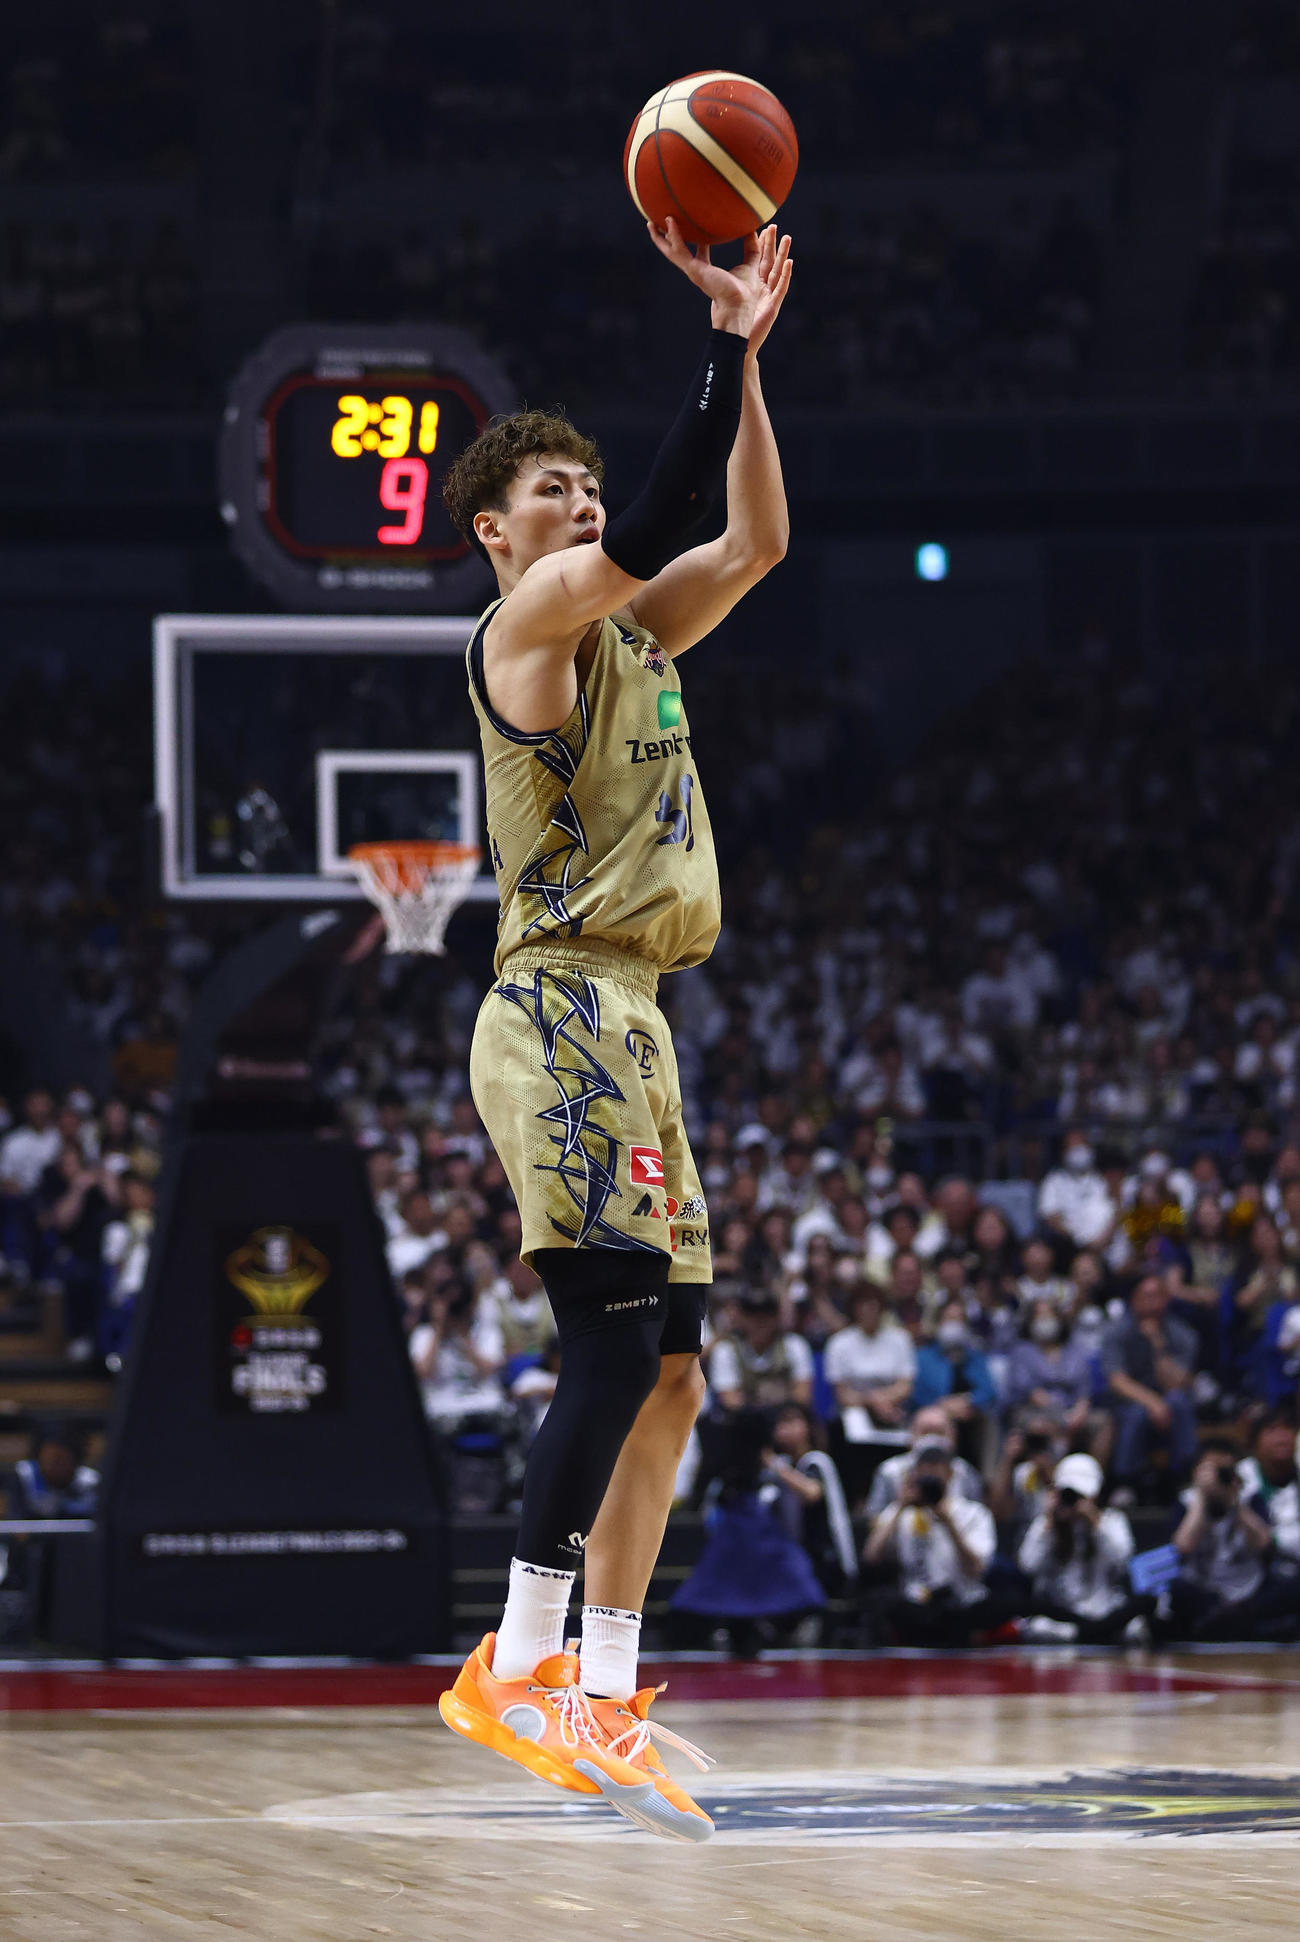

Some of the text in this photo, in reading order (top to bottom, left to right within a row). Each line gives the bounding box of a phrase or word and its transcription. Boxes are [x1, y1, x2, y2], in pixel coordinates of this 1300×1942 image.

[331, 395, 439, 458] 2:31
[377, 457, 429, 545] 9
[589, 1606, 618, 1618] FIVE
